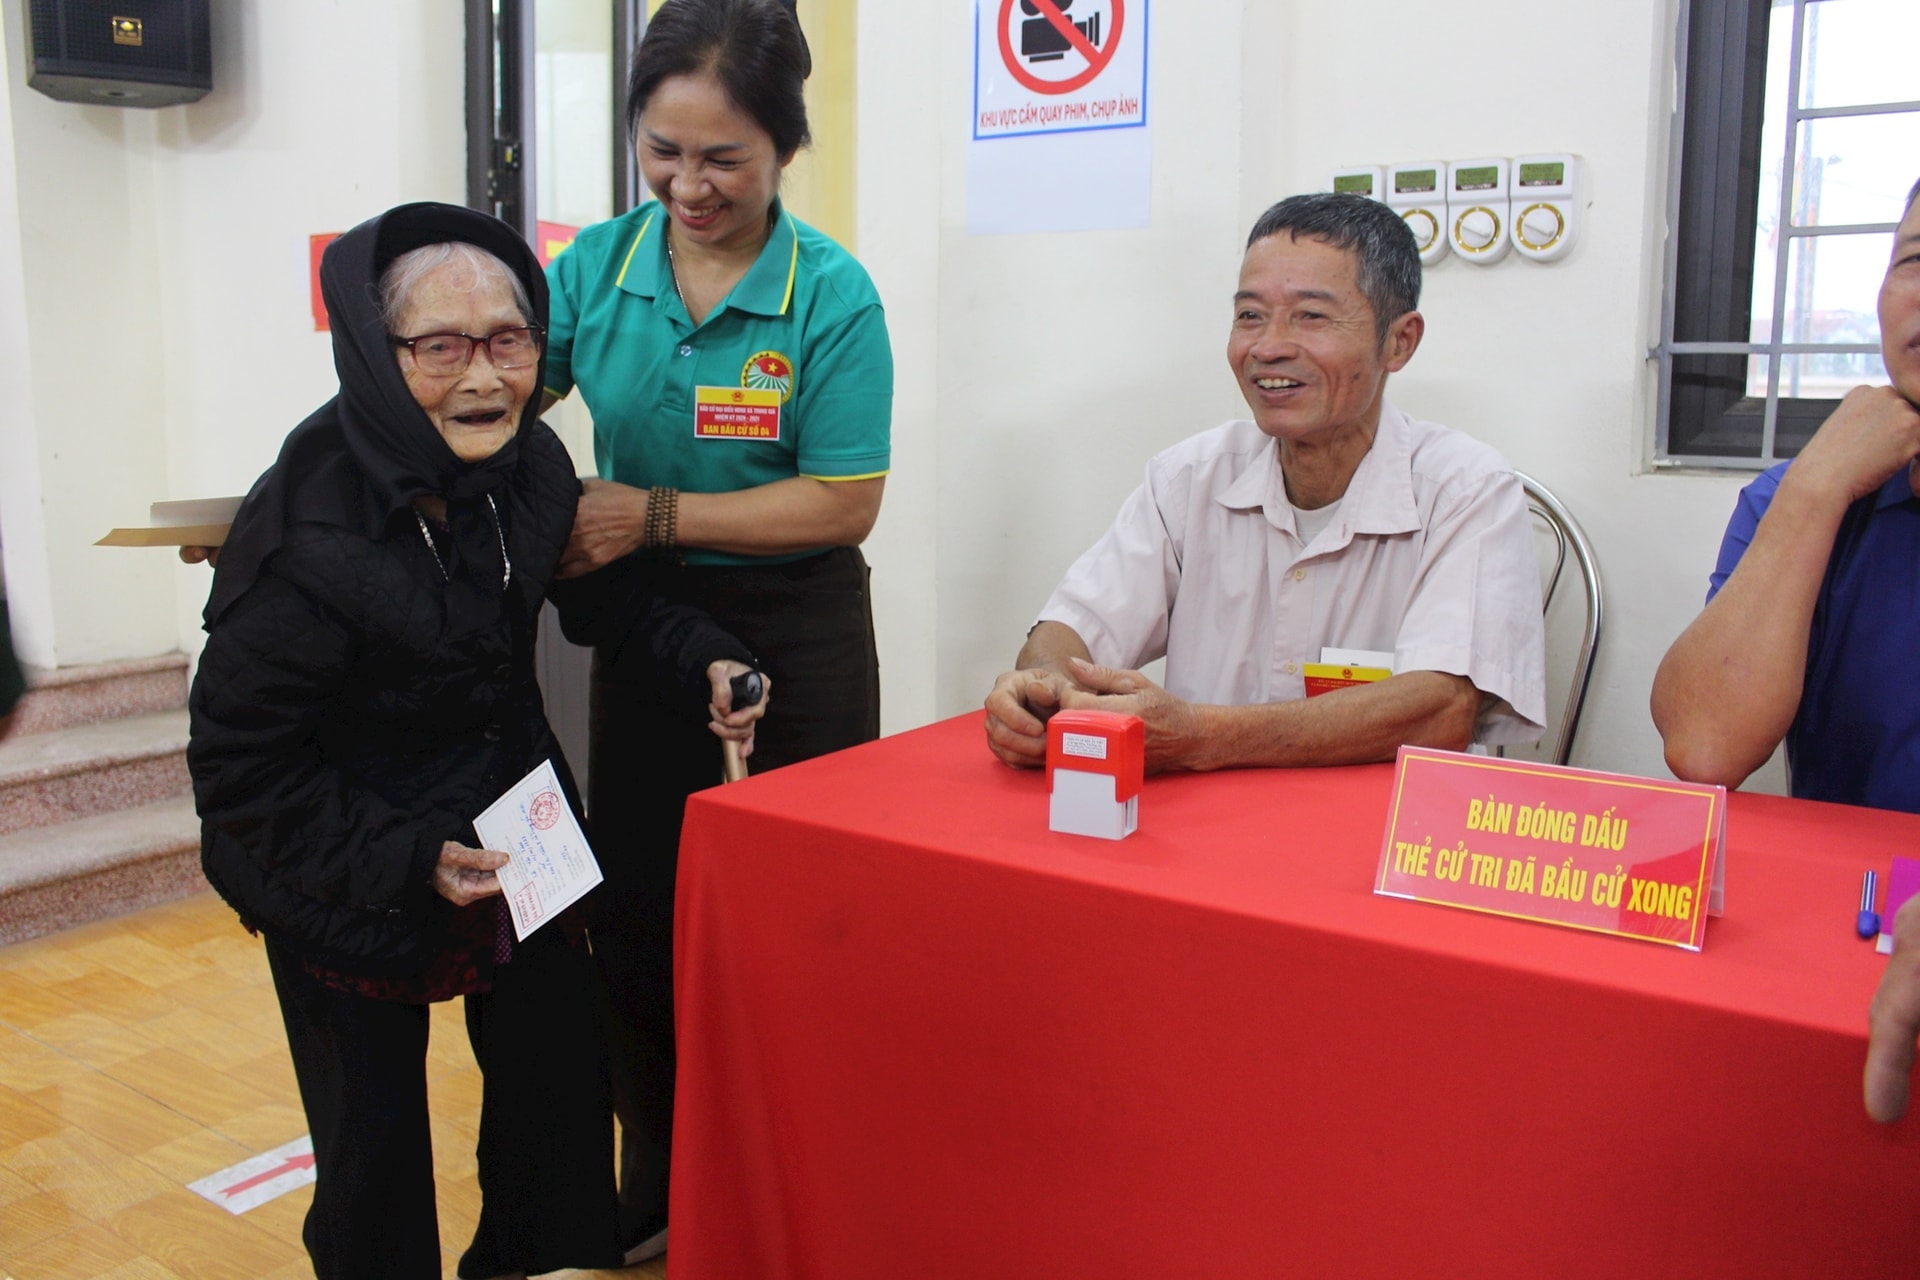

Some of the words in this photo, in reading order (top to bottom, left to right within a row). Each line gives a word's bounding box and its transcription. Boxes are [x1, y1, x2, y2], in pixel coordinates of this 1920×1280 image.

[980, 112, 997, 128] KHU
[1000, 108, 1018, 128] VỰC
[1019, 101, 1037, 125] CẤM
[1039, 105, 1063, 125] QUAY
[1064, 102, 1089, 121] PHIM,
[1091, 100, 1117, 121] CHỤP
[1118, 94, 1138, 116] ẢNH
[703, 424, 719, 434] BAN
[720, 423, 736, 434] BẦU
[736, 423, 748, 435] CỬ
[748, 424, 759, 436] SỐ
[1466, 794, 1513, 834] BÀN
[1515, 801, 1577, 844] ĐÓNG
[1580, 806, 1628, 851] DẤU
[1394, 835, 1432, 877] THẺ
[1434, 840, 1468, 882] CỬ
[1469, 853, 1503, 889] TRI
[1505, 855, 1536, 894] ĐÃ
[1540, 857, 1588, 902] BẦU
[1591, 864, 1627, 908] CỬ
[1626, 878, 1693, 920] XONG
